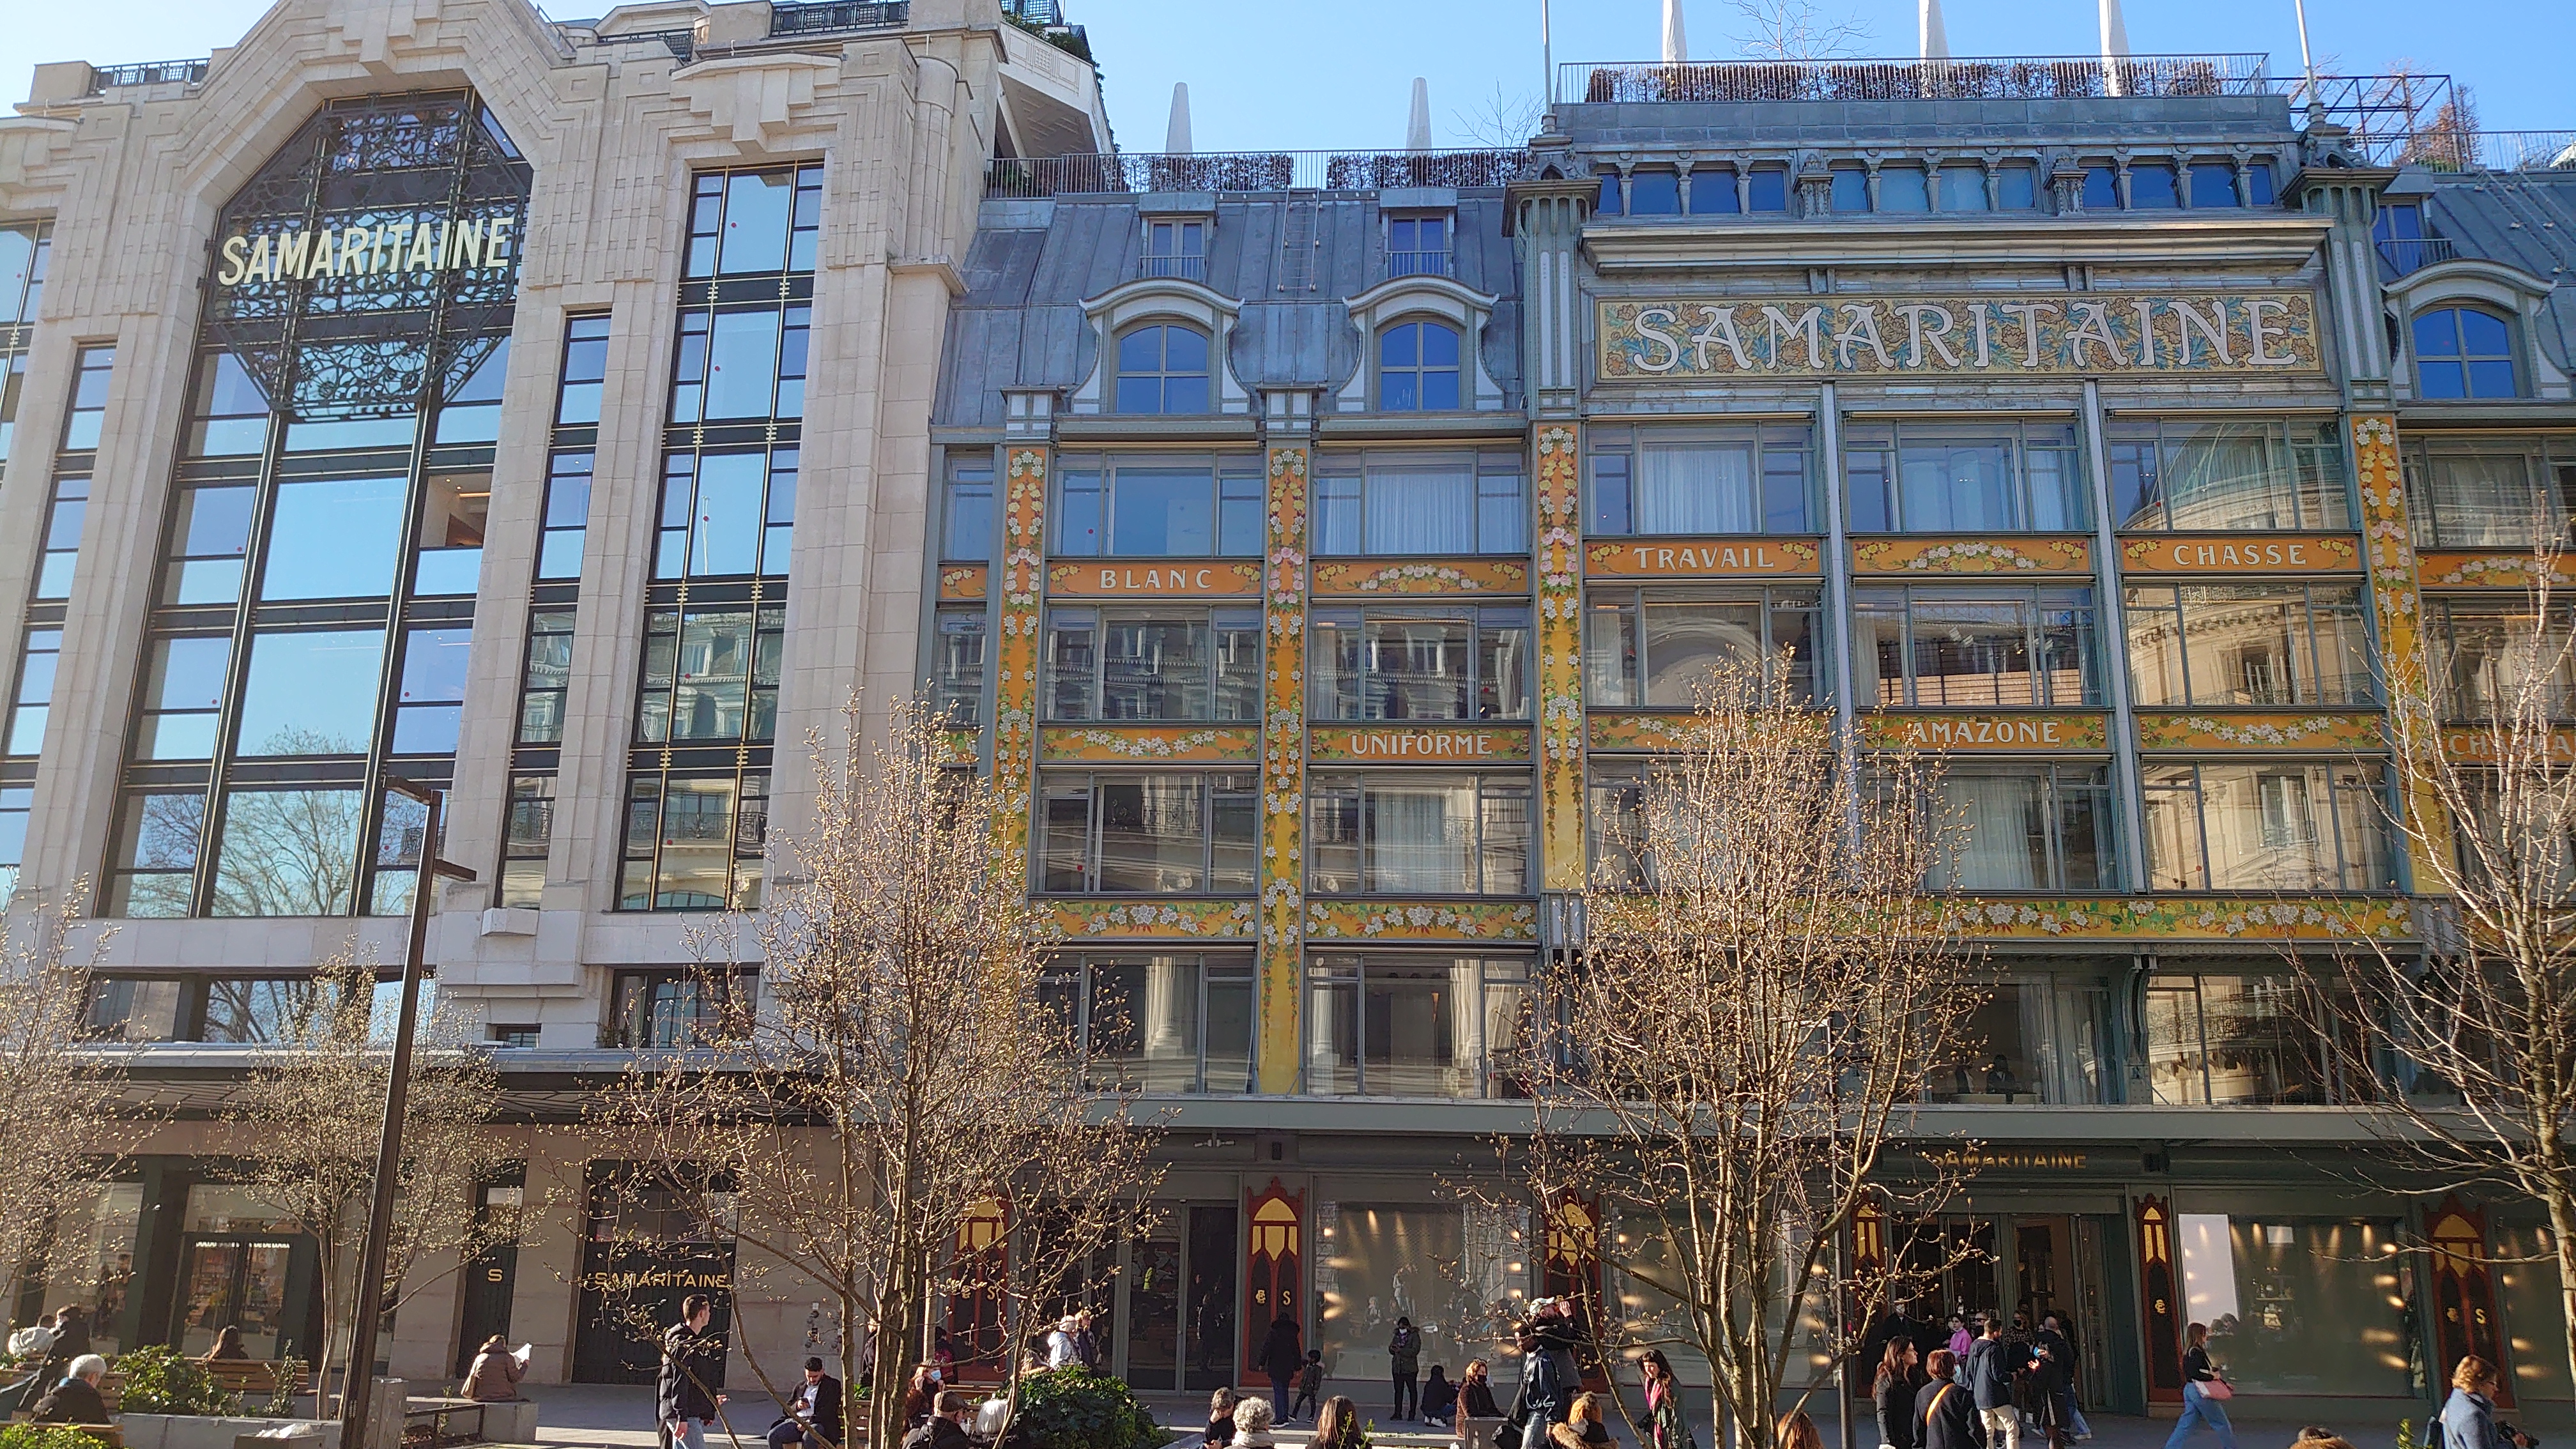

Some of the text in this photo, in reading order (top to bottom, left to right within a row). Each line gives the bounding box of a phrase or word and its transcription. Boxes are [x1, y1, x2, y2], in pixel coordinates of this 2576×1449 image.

[218, 217, 514, 286] SAMARITAINE
[1633, 300, 2297, 371] SAMARITAINE
[1632, 548, 1775, 571] TRAVAIL
[2173, 544, 2306, 565] CHASSE
[1100, 569, 1212, 589] BLANC
[1912, 721, 2060, 742] AMAZONE
[1351, 734, 1493, 756] UNIFORME
[1932, 1151, 2086, 1169] SAMARITAINE
[488, 1269, 503, 1281] S
[594, 1272, 728, 1287] SAMARITAINE
[1283, 1291, 1291, 1305] S
